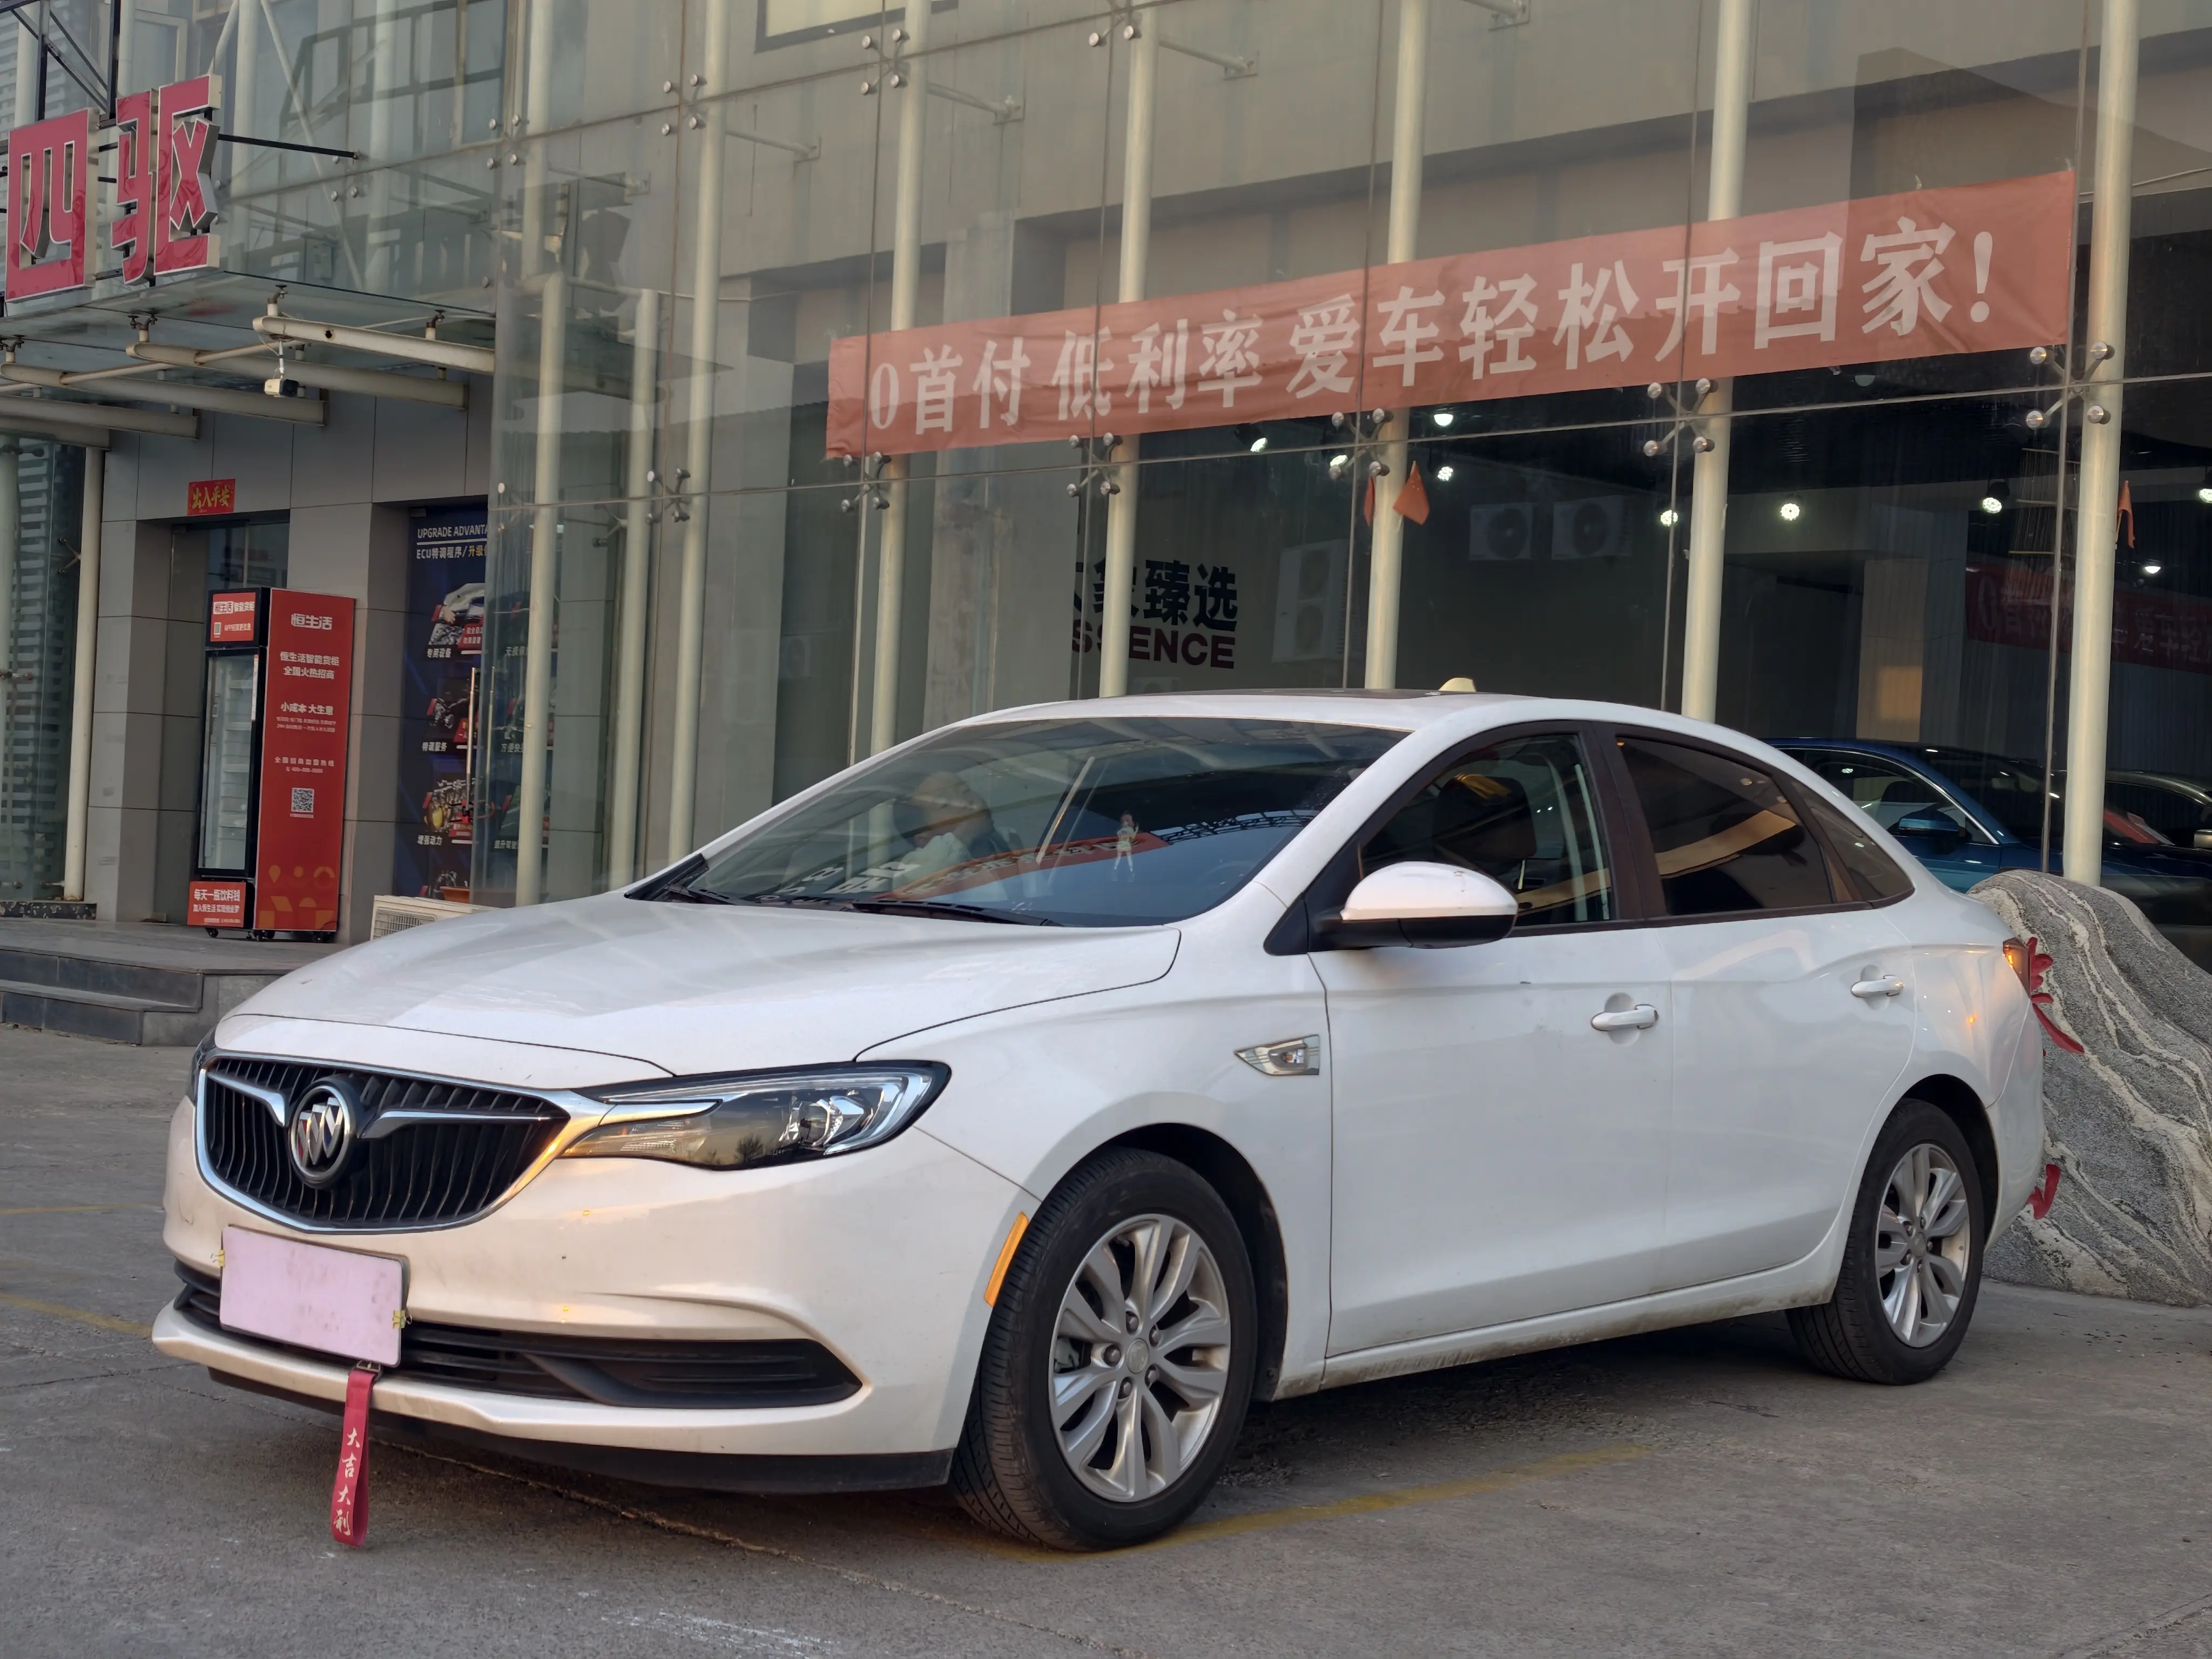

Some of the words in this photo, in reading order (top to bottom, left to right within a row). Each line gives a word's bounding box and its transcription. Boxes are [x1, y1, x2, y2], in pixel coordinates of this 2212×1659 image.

[5, 75, 221, 302] 四驱
[869, 336, 1031, 436] 0首付
[1051, 309, 1264, 421] 低利率
[416, 544, 486, 559] ECU特调程序/升级
[417, 527, 452, 539] UPGRADE
[291, 613, 333, 630] 恒生活
[1072, 619, 1236, 669] SENCE
[333, 1427, 360, 1536] 大吉大利
